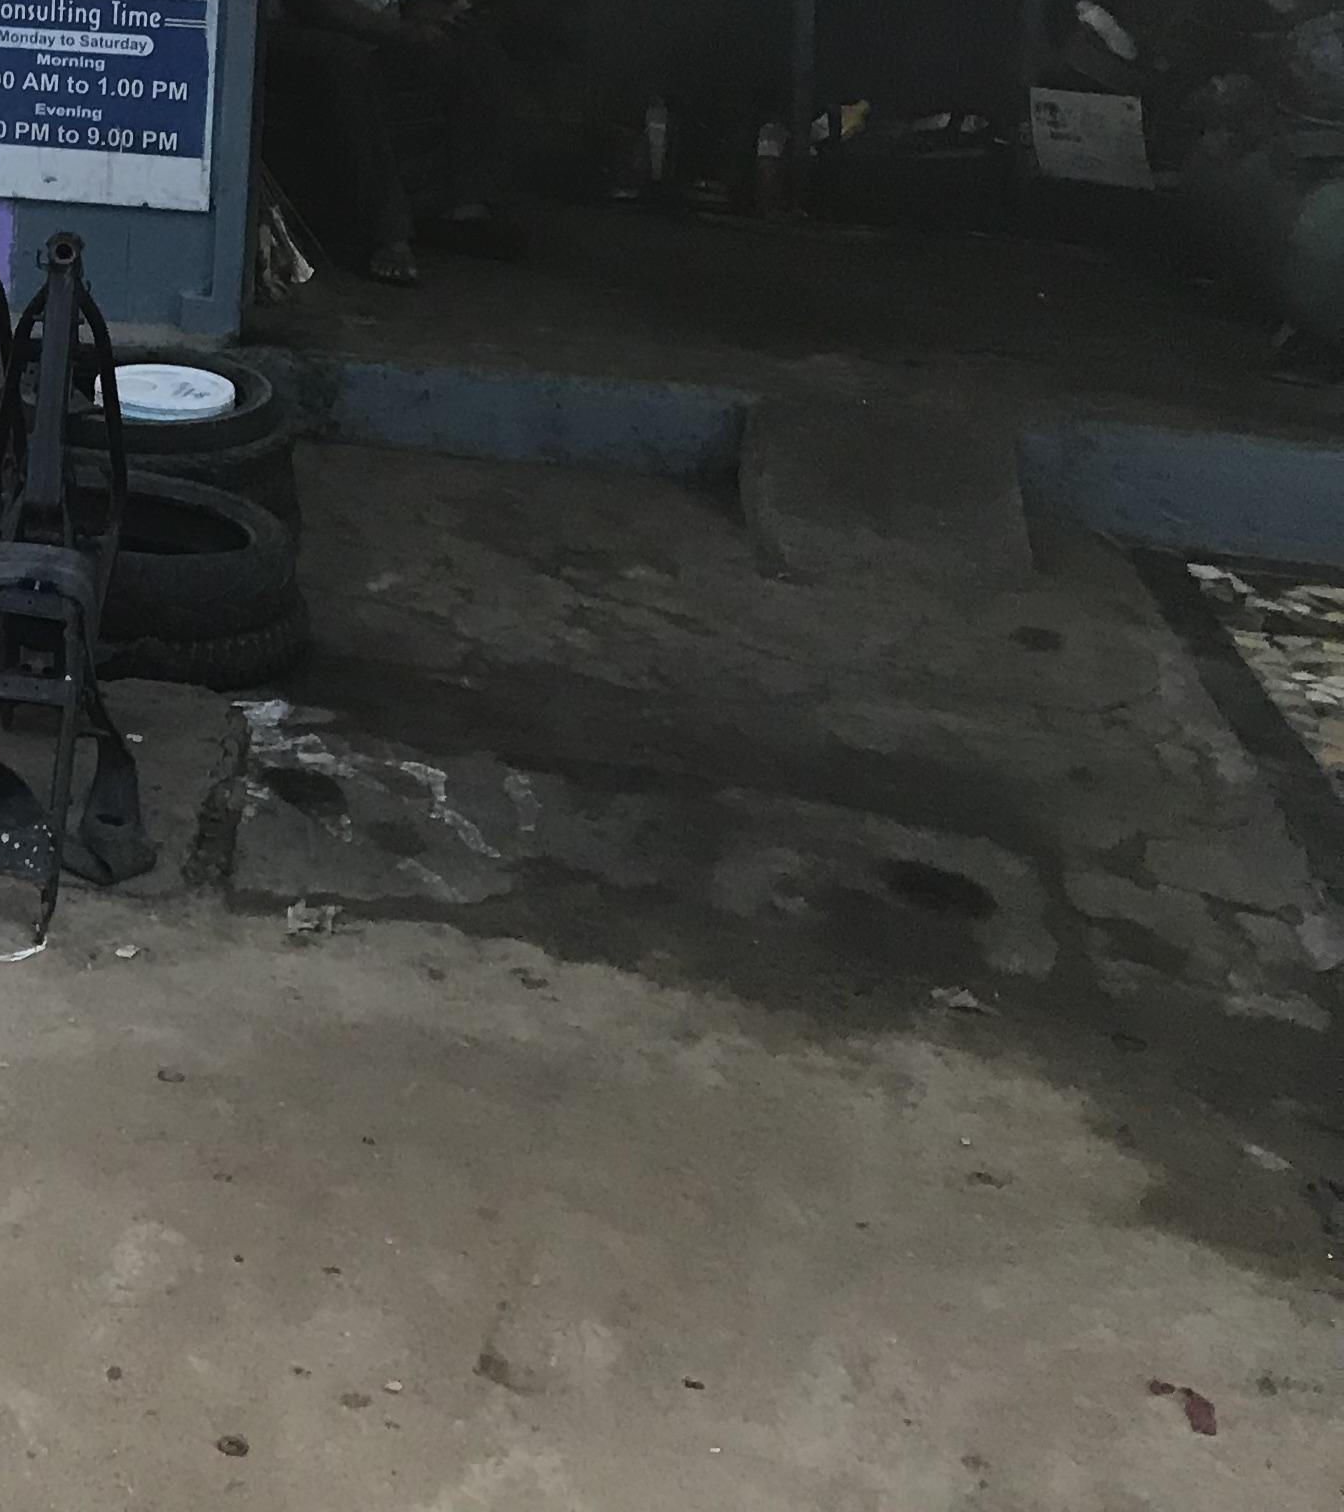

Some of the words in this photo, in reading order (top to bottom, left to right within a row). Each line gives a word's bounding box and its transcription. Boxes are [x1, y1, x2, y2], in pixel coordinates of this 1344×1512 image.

[111, 0, 162, 29] Time
[60, 33, 76, 47] to
[79, 34, 148, 53] Saturday
[36, 53, 106, 72] Morning
[22, 72, 60, 93] AM
[67, 75, 90, 95] to
[97, 76, 144, 98] 1.00
[152, 80, 189, 101] PM
[34, 102, 103, 122] Evening
[14, 121, 50, 142] PM
[57, 124, 80, 144] to
[87, 126, 134, 148] 9.00
[141, 130, 179, 152] PM
